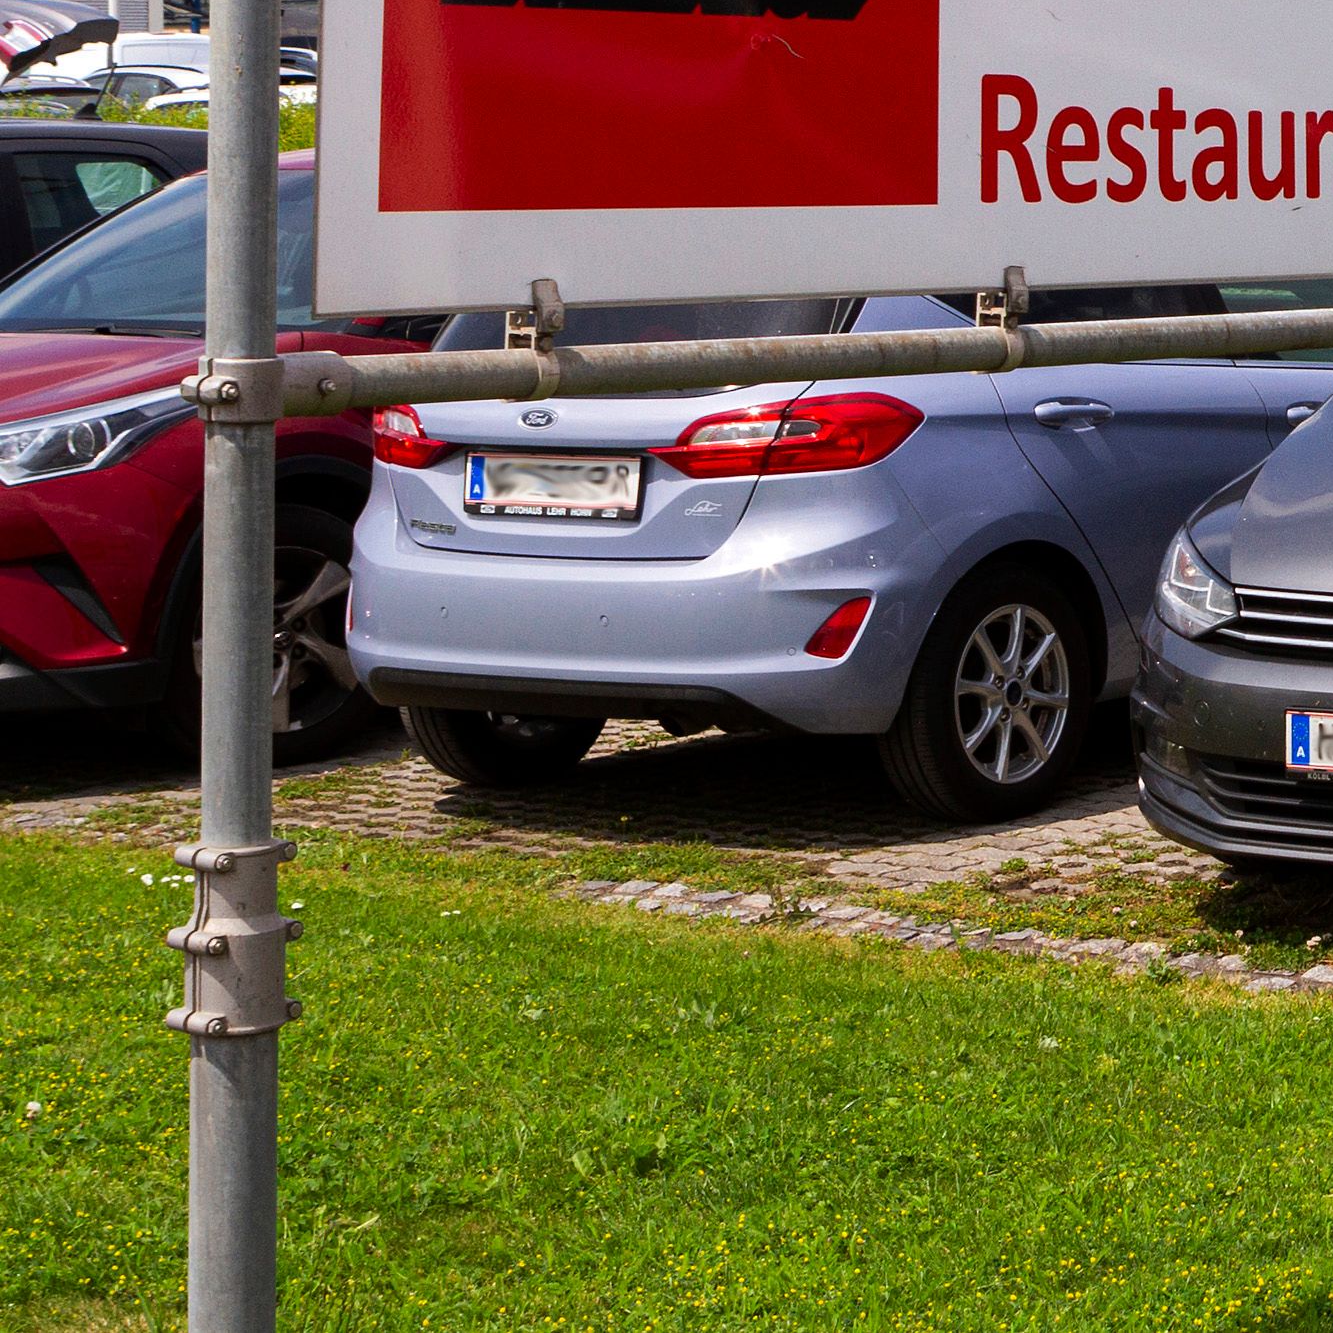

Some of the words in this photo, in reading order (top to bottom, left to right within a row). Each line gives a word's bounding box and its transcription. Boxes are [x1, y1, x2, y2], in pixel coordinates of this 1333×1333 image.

[472, 484, 482, 495] A
[504, 506, 543, 515] AUTOHAUS
[546, 507, 566, 516] LEHR
[1296, 745, 1306, 758] A
